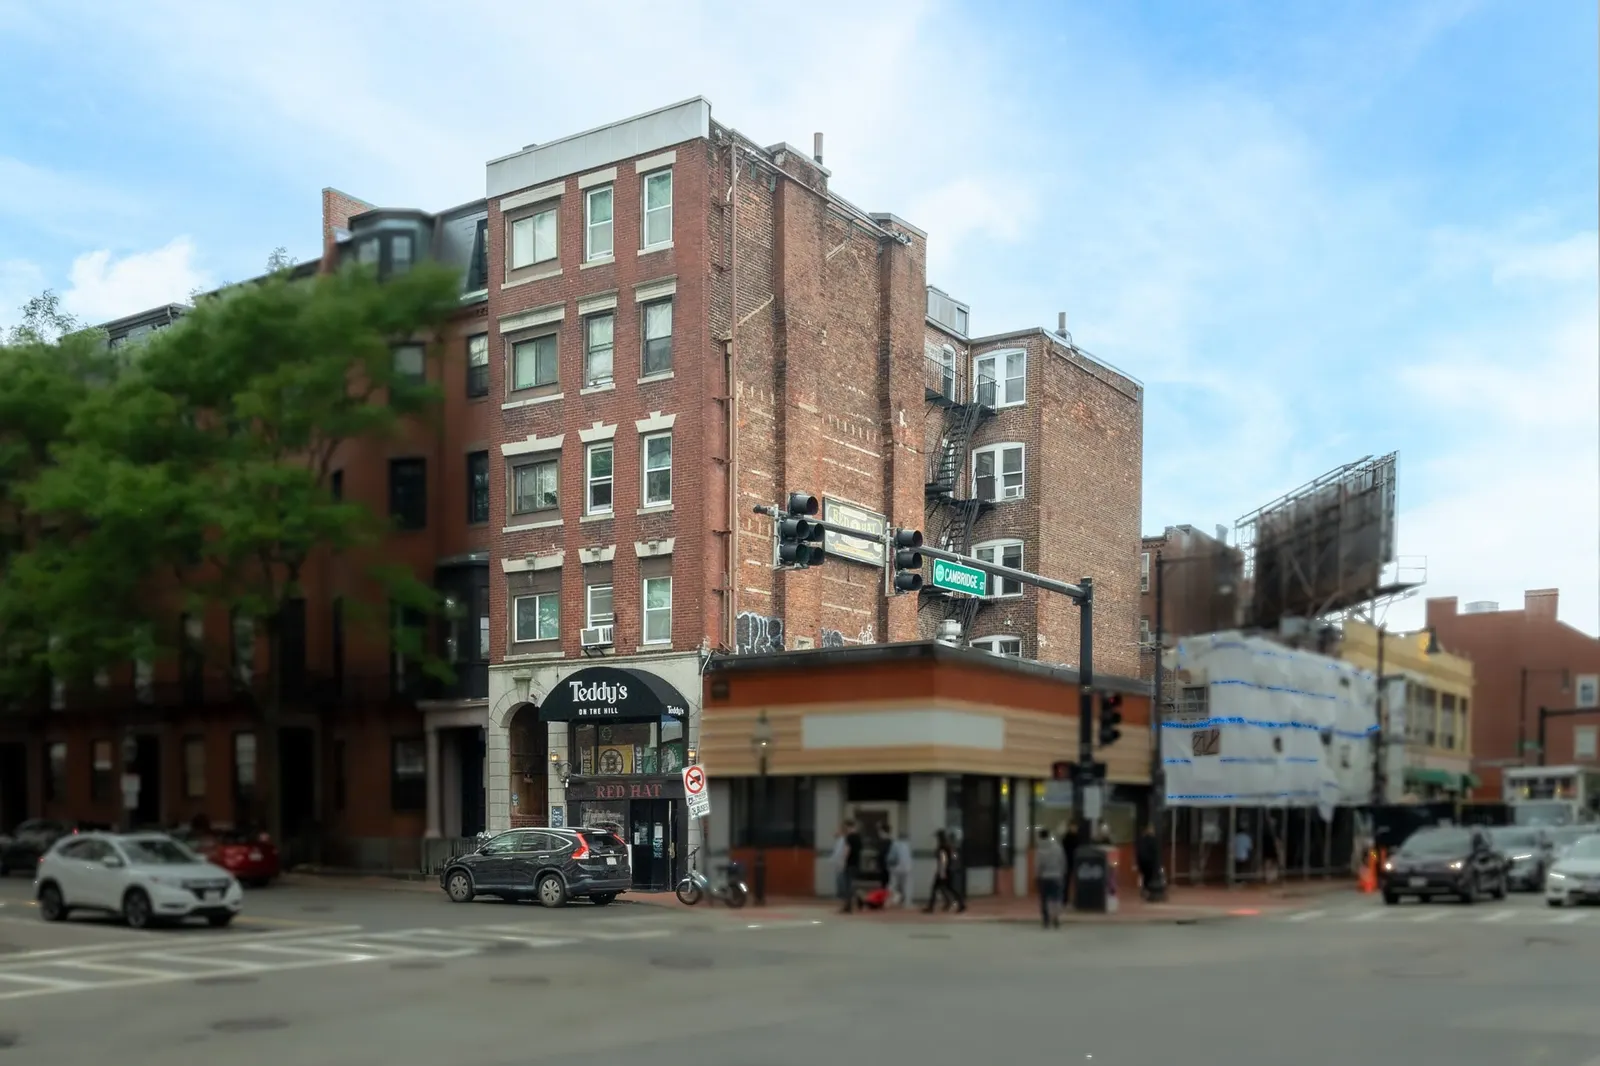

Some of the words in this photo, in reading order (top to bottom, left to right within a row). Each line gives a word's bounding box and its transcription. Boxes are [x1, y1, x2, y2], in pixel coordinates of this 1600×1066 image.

[944, 567, 979, 589] CAMBRIDGE
[979, 581, 985, 590] ST
[569, 680, 628, 704] Teddy's
[578, 708, 588, 716] ON
[589, 707, 601, 715] THE
[603, 707, 619, 715] HILL
[667, 705, 685, 716] Teddy's
[596, 784, 625, 798] RED
[630, 783, 663, 798] HAT
